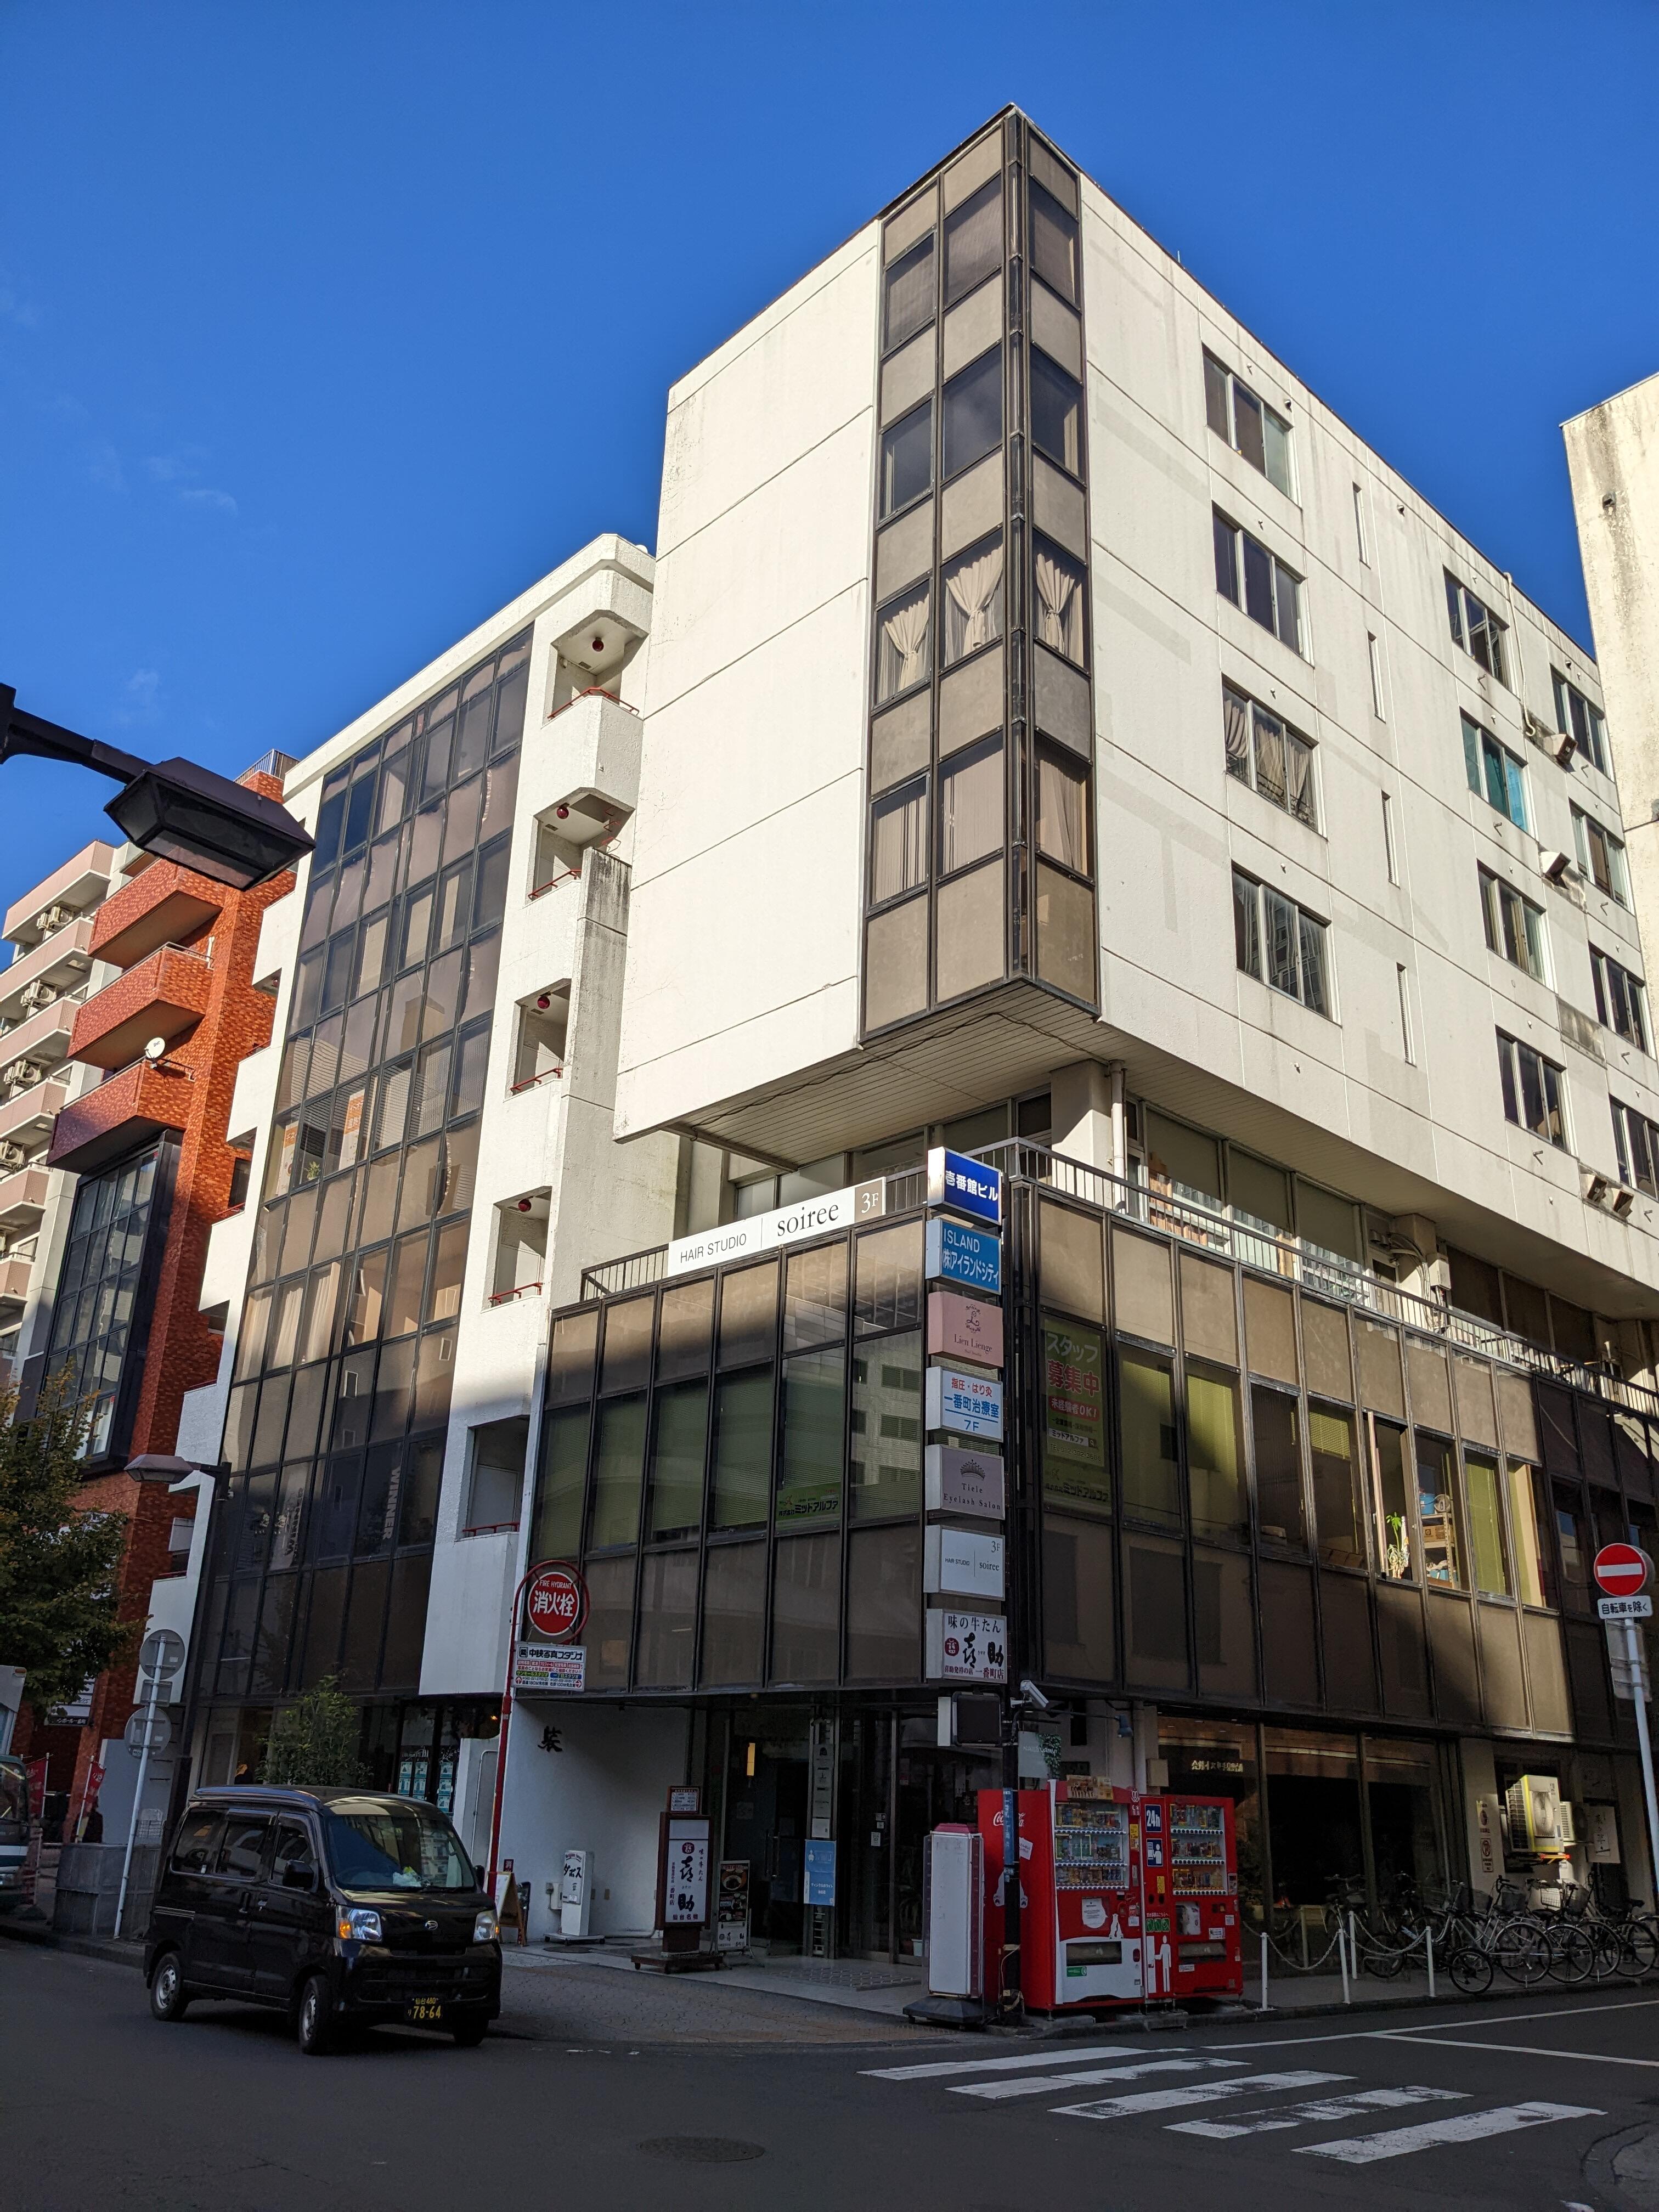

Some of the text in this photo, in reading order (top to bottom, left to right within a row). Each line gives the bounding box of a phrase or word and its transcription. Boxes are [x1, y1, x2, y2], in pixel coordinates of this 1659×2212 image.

[946, 1170, 998, 1201] 壱番館ビル
[680, 1192, 879, 1263] HAIR STUDIO soiree 3F
[944, 1228, 980, 1253] ISLAND
[954, 1334, 969, 1346] Lien
[1047, 1332, 1098, 1363] スタッフ
[1047, 1359, 1101, 1397] 募集中
[951, 1377, 992, 1397] 指圧・はり灸
[944, 1393, 999, 1418] 一番町治療室
[964, 1419, 979, 1431] 7F
[962, 1483, 983, 1493] Tiele
[944, 1493, 1001, 1510] Eyelash Salon
[991, 1541, 1001, 1553] 3F
[979, 1561, 1000, 1571] soiree
[550, 1580, 572, 1590] HYDRANT
[533, 1590, 575, 1617] 消火栓
[1601, 1601, 1647, 1615] 自転車を除く
[948, 1615, 1001, 1633] 味の牛たん
[975, 1667, 1004, 1679] 一番町店
[1146, 1810, 1161, 1827] 24h
[413, 2005, 441, 2019] 78-64
